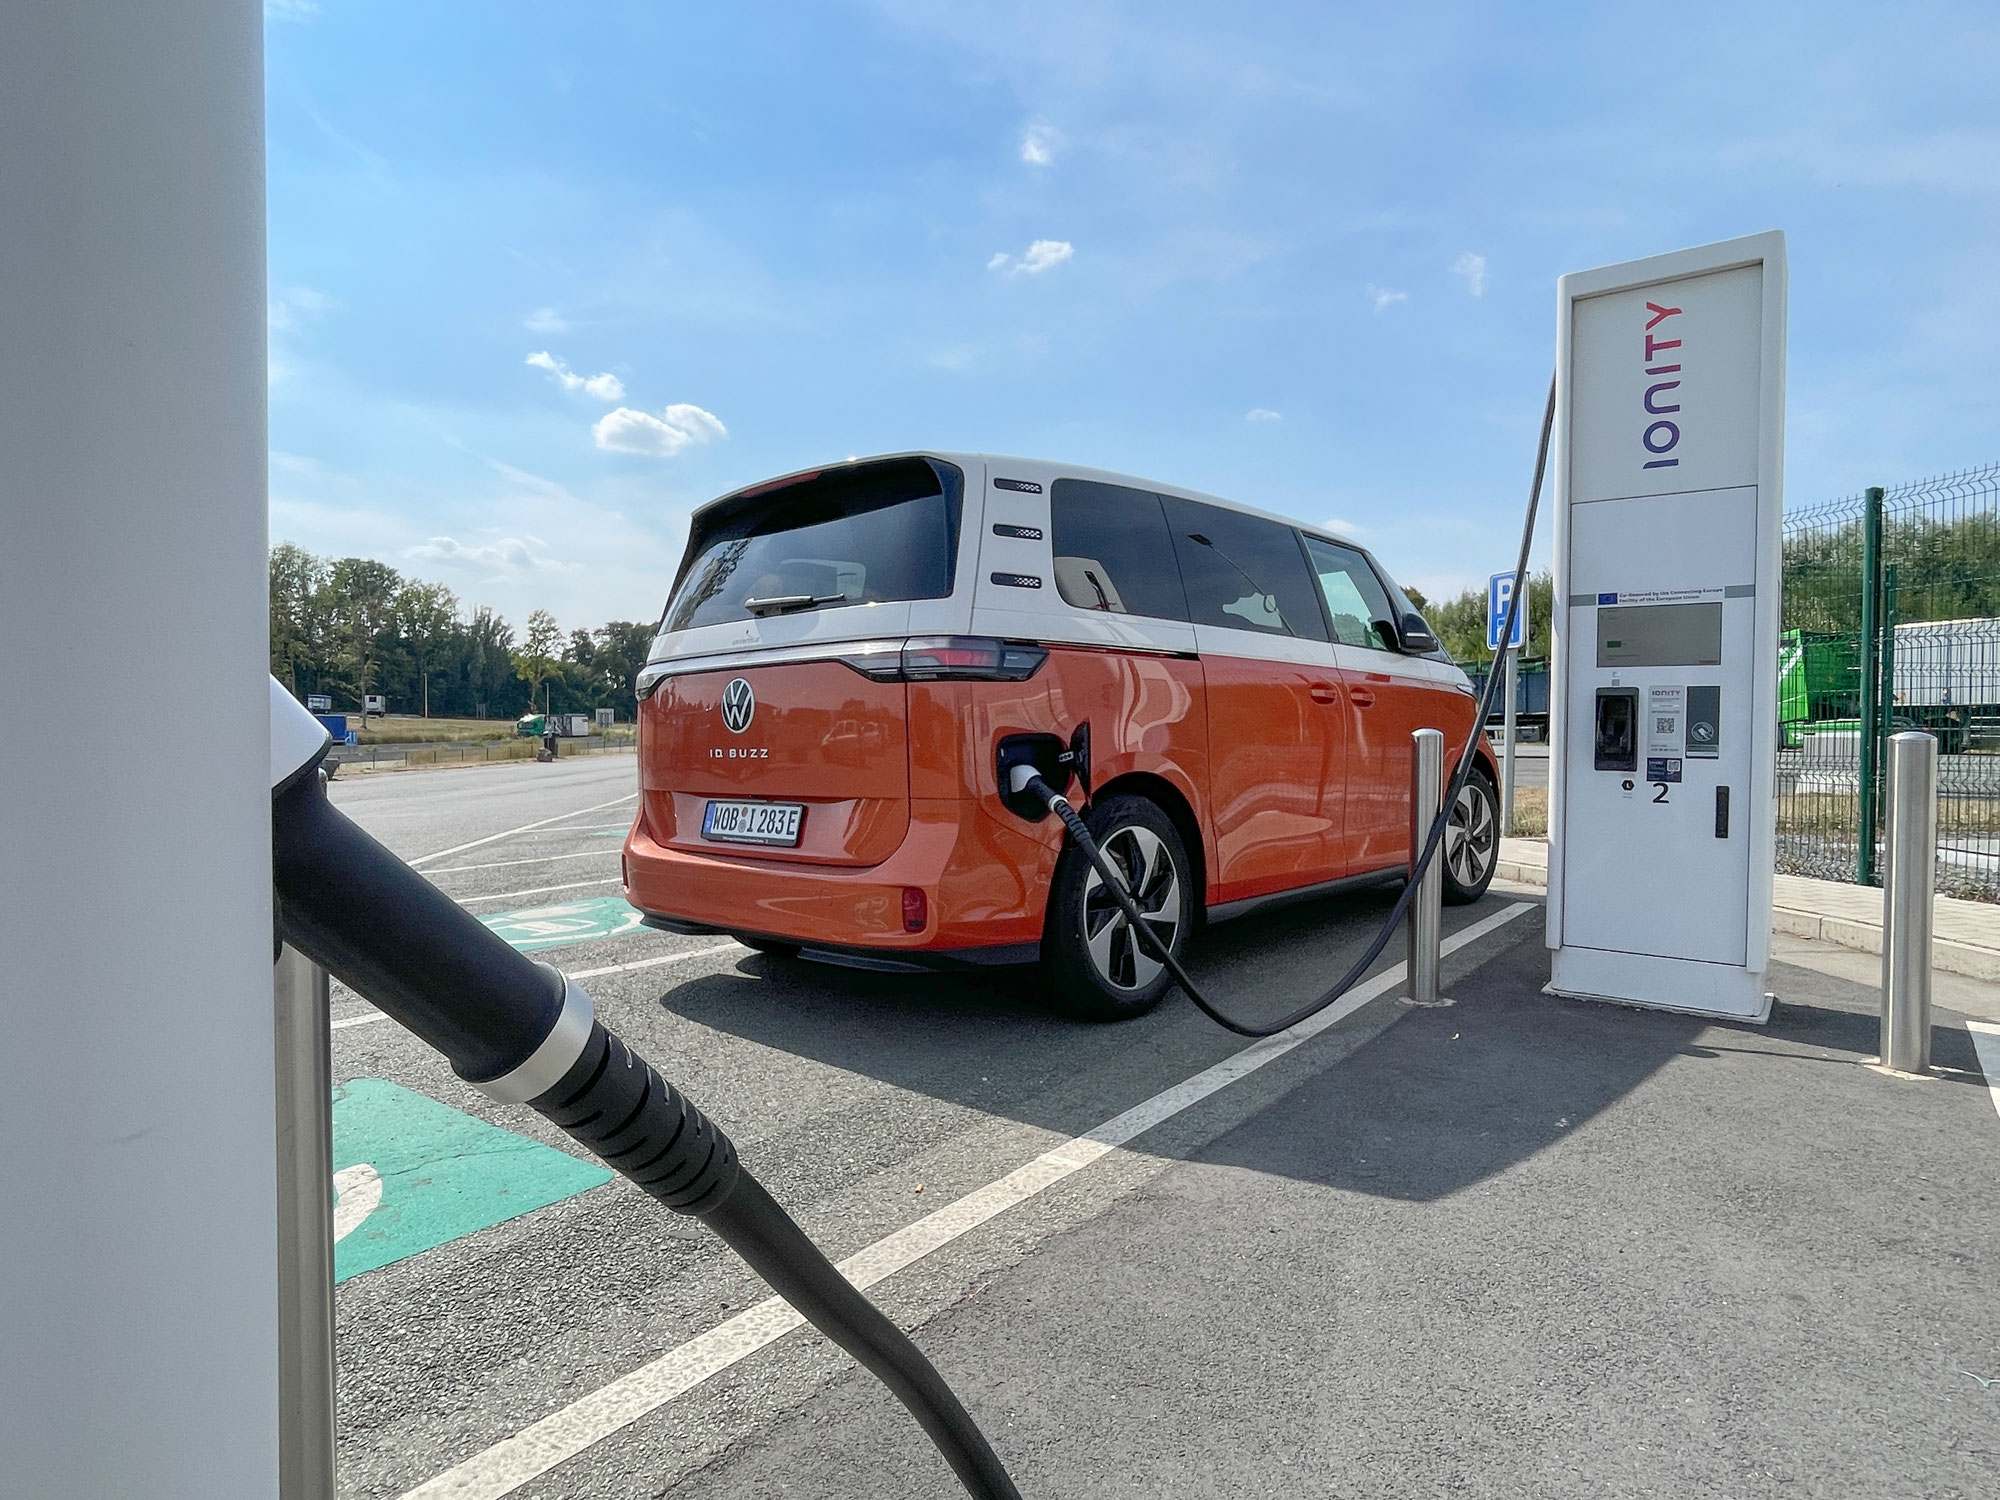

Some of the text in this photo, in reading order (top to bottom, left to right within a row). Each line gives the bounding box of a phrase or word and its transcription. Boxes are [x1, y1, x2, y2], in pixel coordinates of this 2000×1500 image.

[1643, 301, 1683, 470] IONITY
[1497, 578, 1514, 614] P
[729, 748, 769, 758] BUZZ
[1652, 782, 1669, 804] 2
[712, 806, 740, 831] WOB
